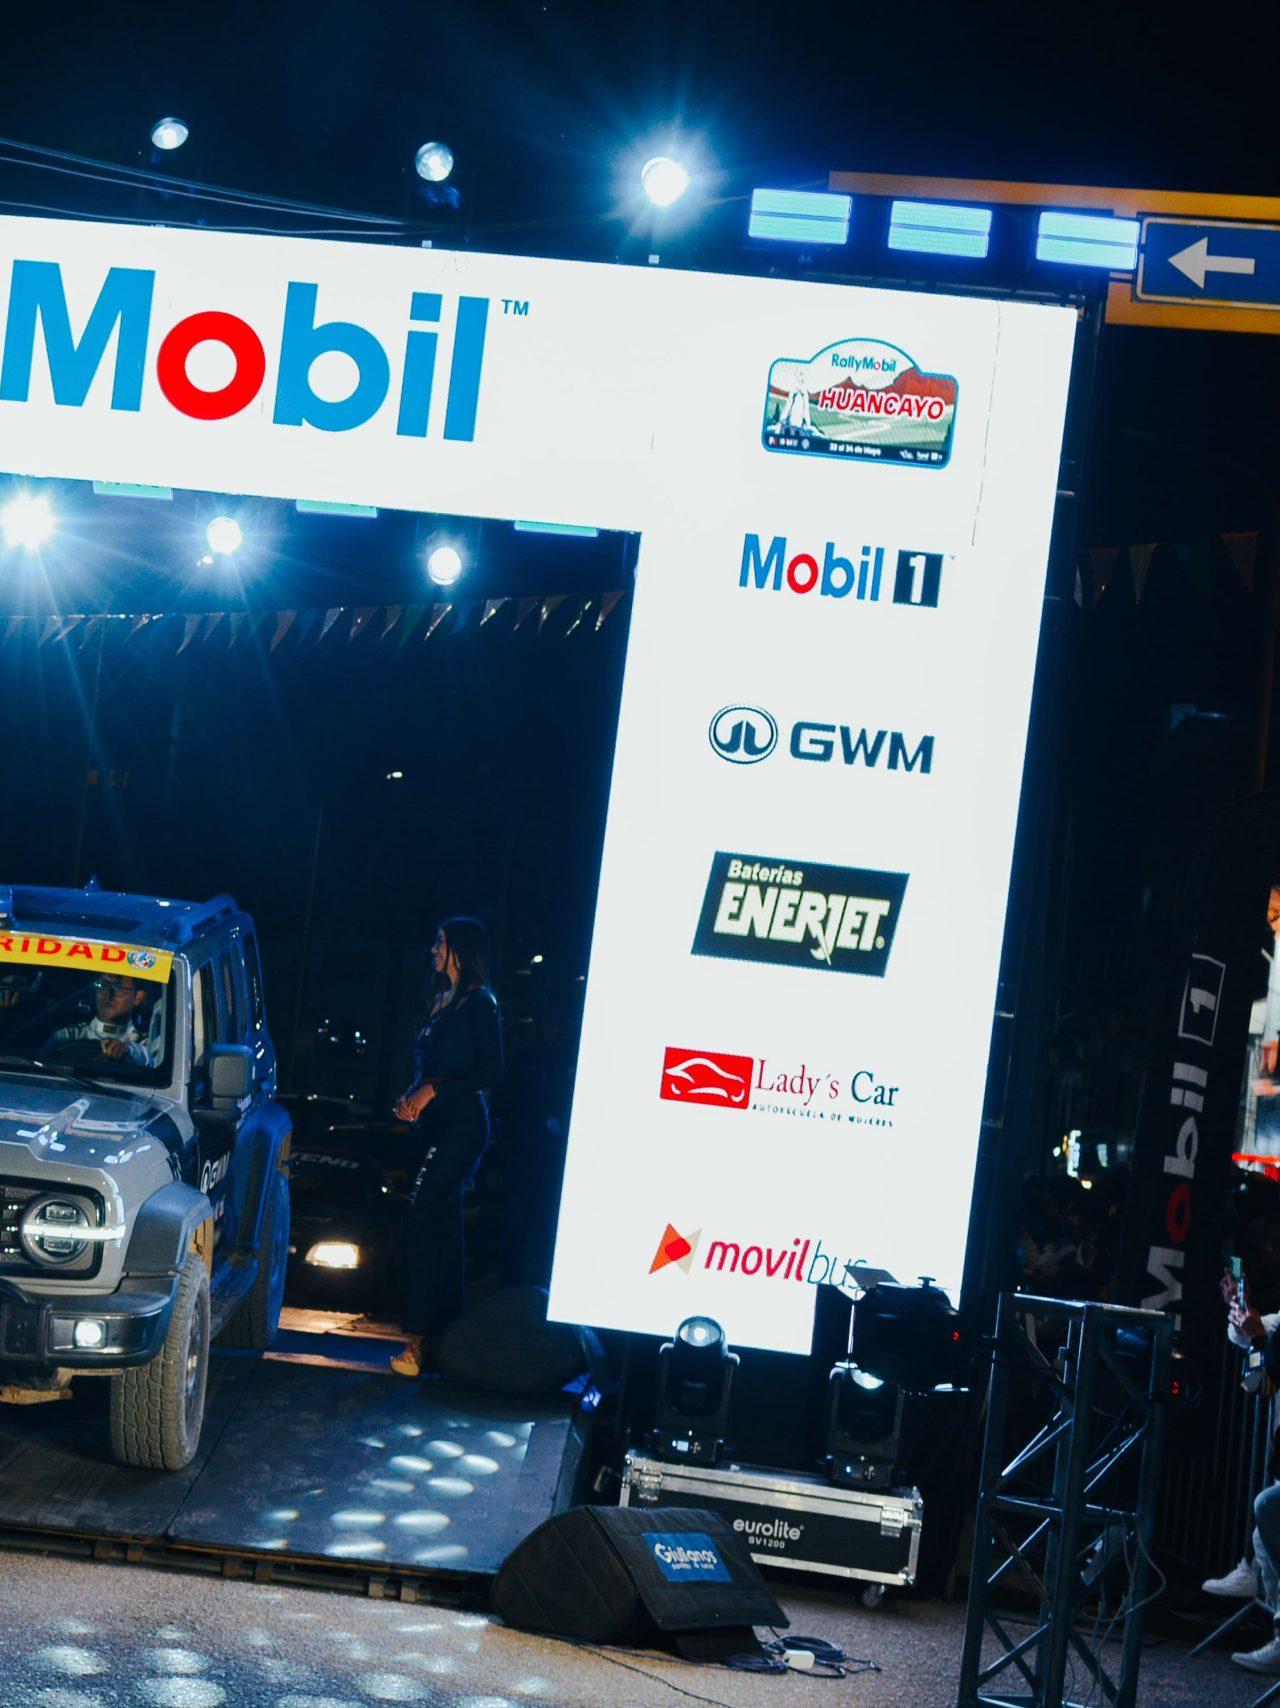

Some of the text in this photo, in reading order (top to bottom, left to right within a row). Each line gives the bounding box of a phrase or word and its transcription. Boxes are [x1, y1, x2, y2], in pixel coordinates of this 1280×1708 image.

[831, 353, 897, 373] RallyMobil
[819, 390, 945, 421] HUANCAYO
[739, 532, 885, 601] Mobil
[789, 721, 935, 774] GWM
[851, 1070, 899, 1107] Car
[732, 1518, 801, 1541] eurolite
